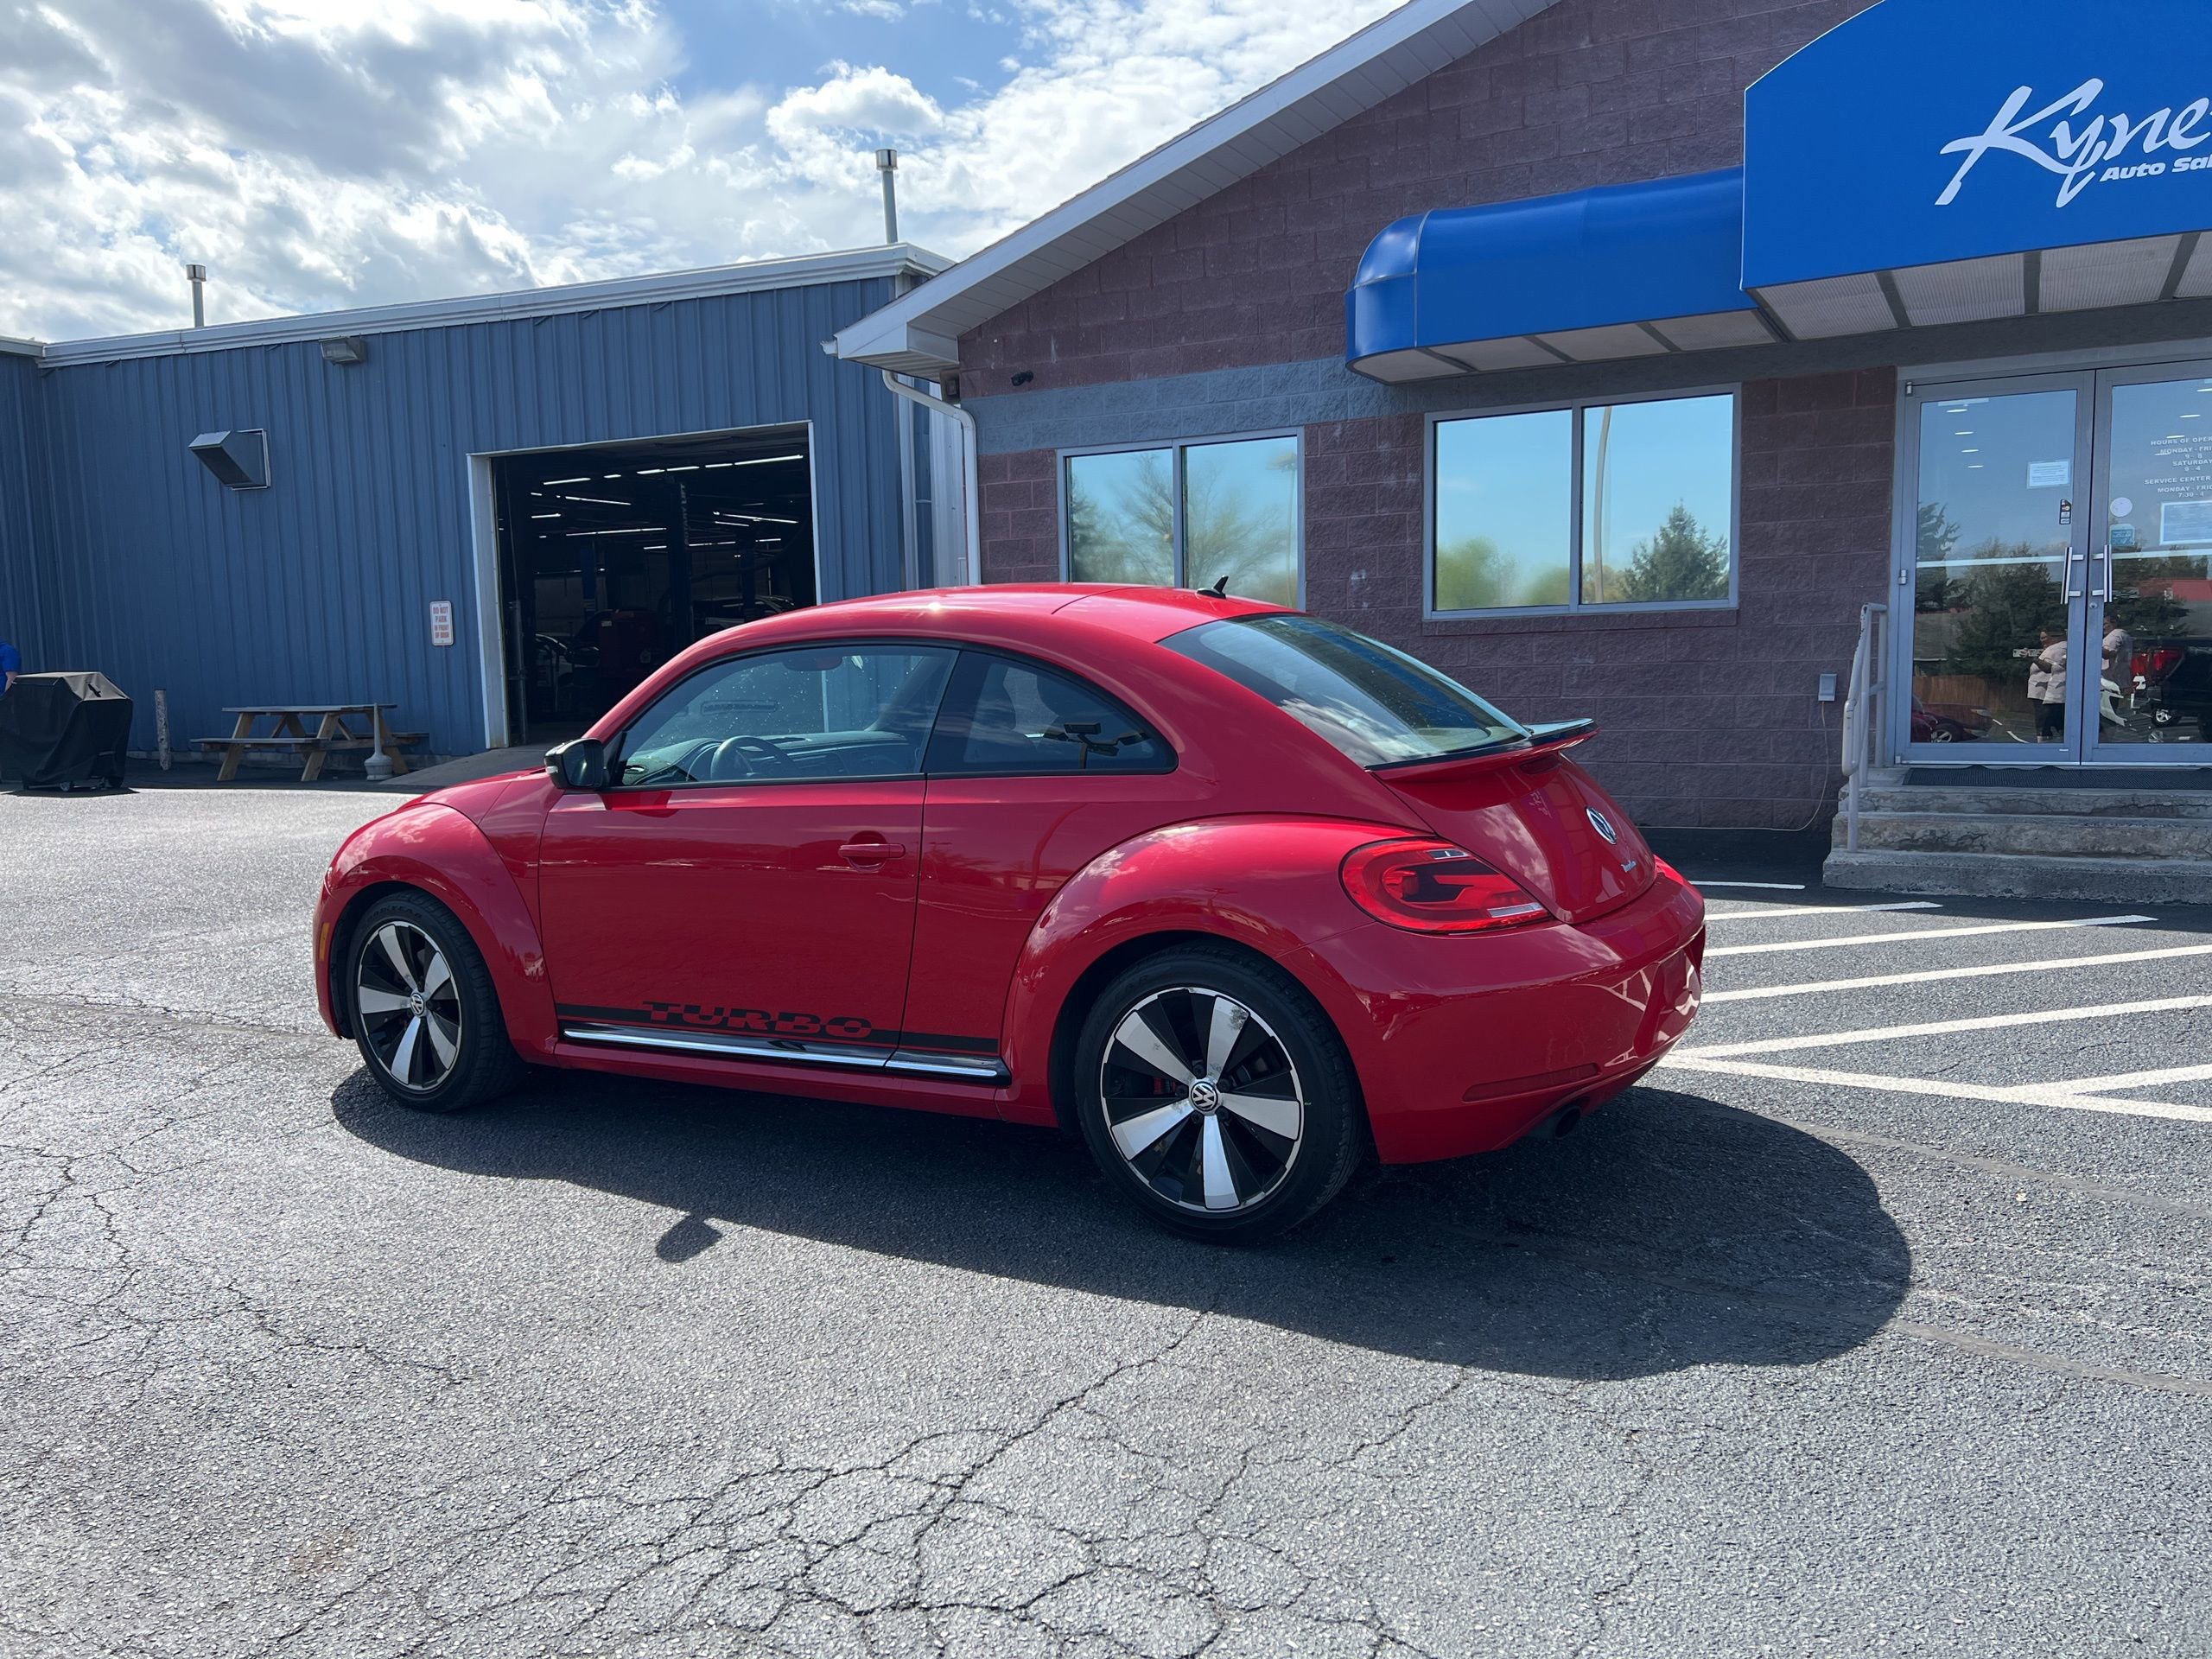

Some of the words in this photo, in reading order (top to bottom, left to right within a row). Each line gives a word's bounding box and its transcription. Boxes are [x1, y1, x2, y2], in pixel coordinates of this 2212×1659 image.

[1935, 78, 2212, 207] Kyne
[2100, 161, 2165, 181] Auto
[643, 1001, 872, 1037] TURBO
